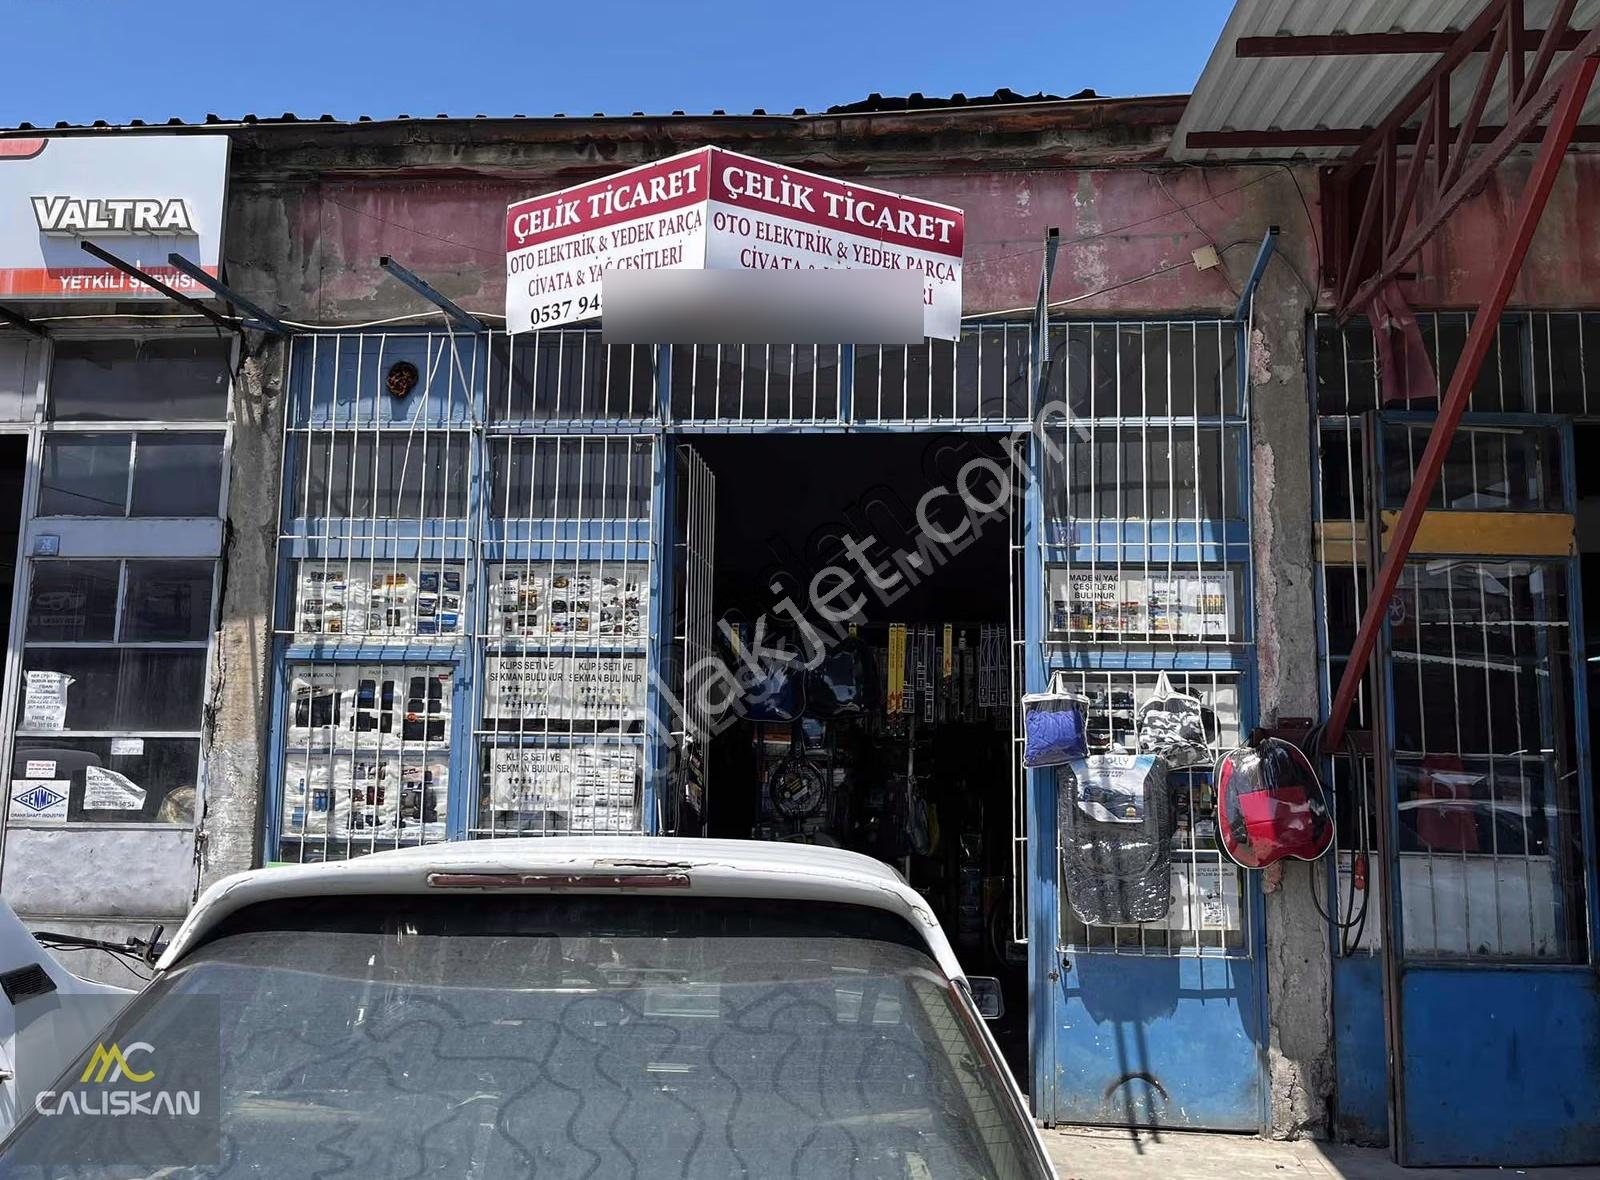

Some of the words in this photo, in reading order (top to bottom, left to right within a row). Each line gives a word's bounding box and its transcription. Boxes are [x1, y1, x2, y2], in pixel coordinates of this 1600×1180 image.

[31, 196, 193, 231] VALTRA
[513, 198, 582, 244] ÇELİK
[587, 164, 701, 219] TİCARET
[722, 166, 816, 213] ÇELİK
[822, 190, 956, 244] TİCARET
[510, 253, 535, 274] OTO
[537, 233, 596, 267] ELEKTRİK
[599, 235, 608, 251] &
[611, 221, 655, 249] YEDEK
[658, 208, 702, 237] PARÇA
[713, 211, 751, 237] OTO
[755, 220, 833, 257] ELEKTRİK
[837, 241, 848, 259] &
[852, 243, 901, 269] YEDEK
[906, 255, 957, 285] PARÇA
[60, 272, 124, 289] YETKİLİ
[528, 271, 571, 297] CİVATA
[576, 269, 585, 285] &
[530, 300, 572, 325] 0537
[578, 294, 602, 314] 94
[506, 752, 529, 761] KLIS
[530, 752, 546, 761] SET
[550, 752, 561, 761] VE
